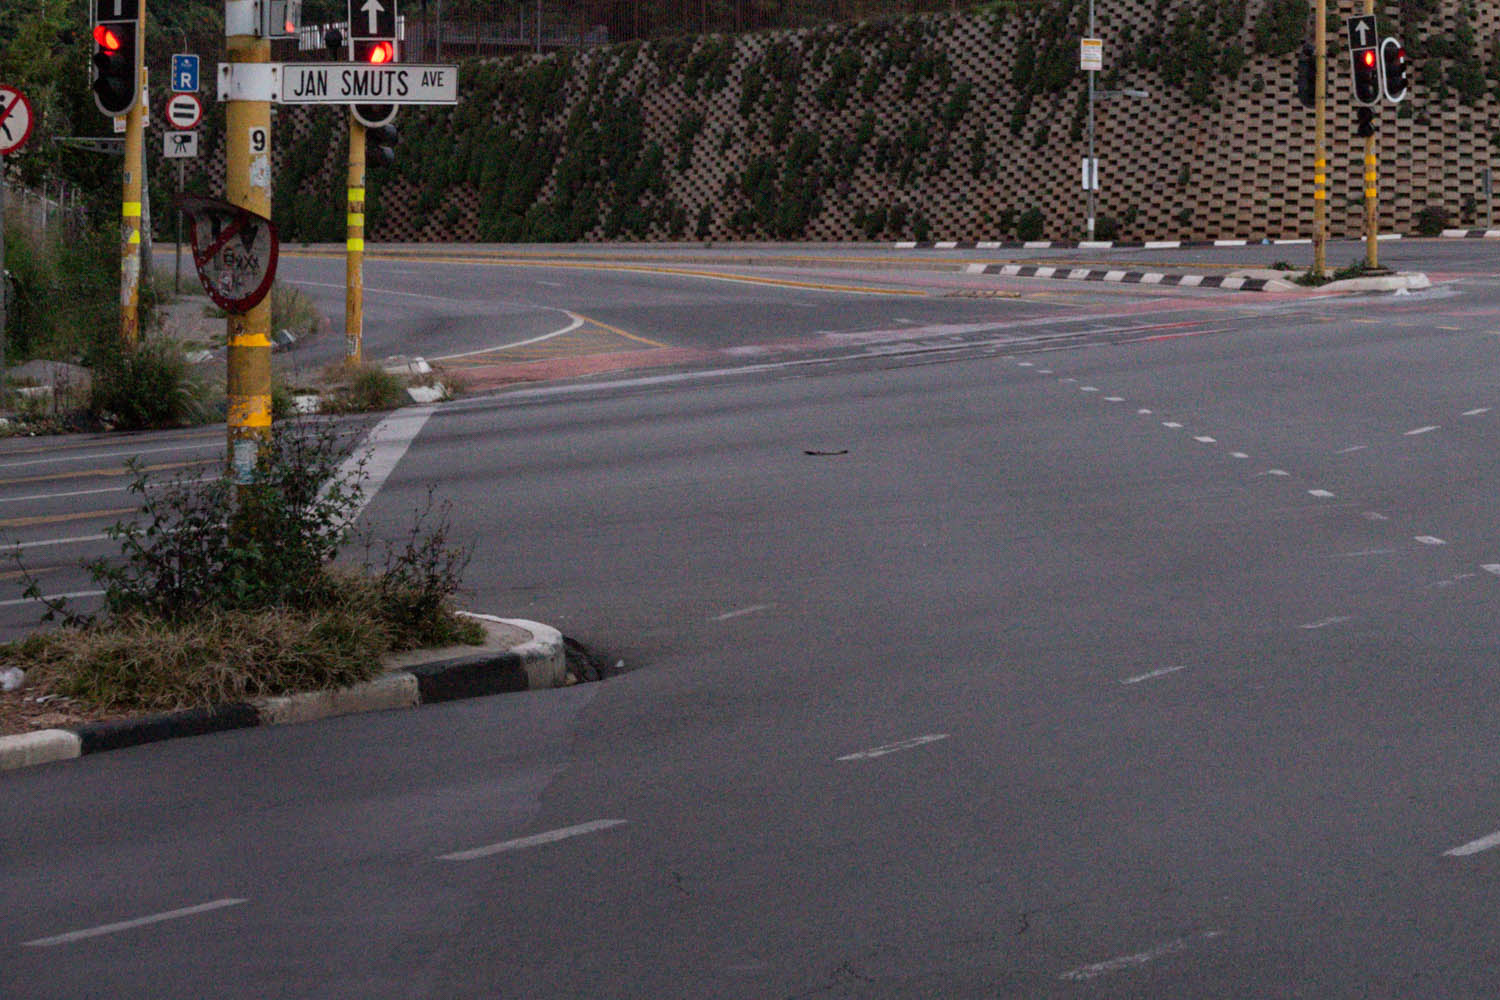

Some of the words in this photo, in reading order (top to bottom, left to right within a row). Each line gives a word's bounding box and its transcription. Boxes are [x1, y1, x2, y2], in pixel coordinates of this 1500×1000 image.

[180, 72, 191, 88] R
[294, 70, 327, 96] JAN
[341, 70, 408, 96] SMUTS
[421, 71, 444, 87] AVE
[252, 130, 266, 151] 9
